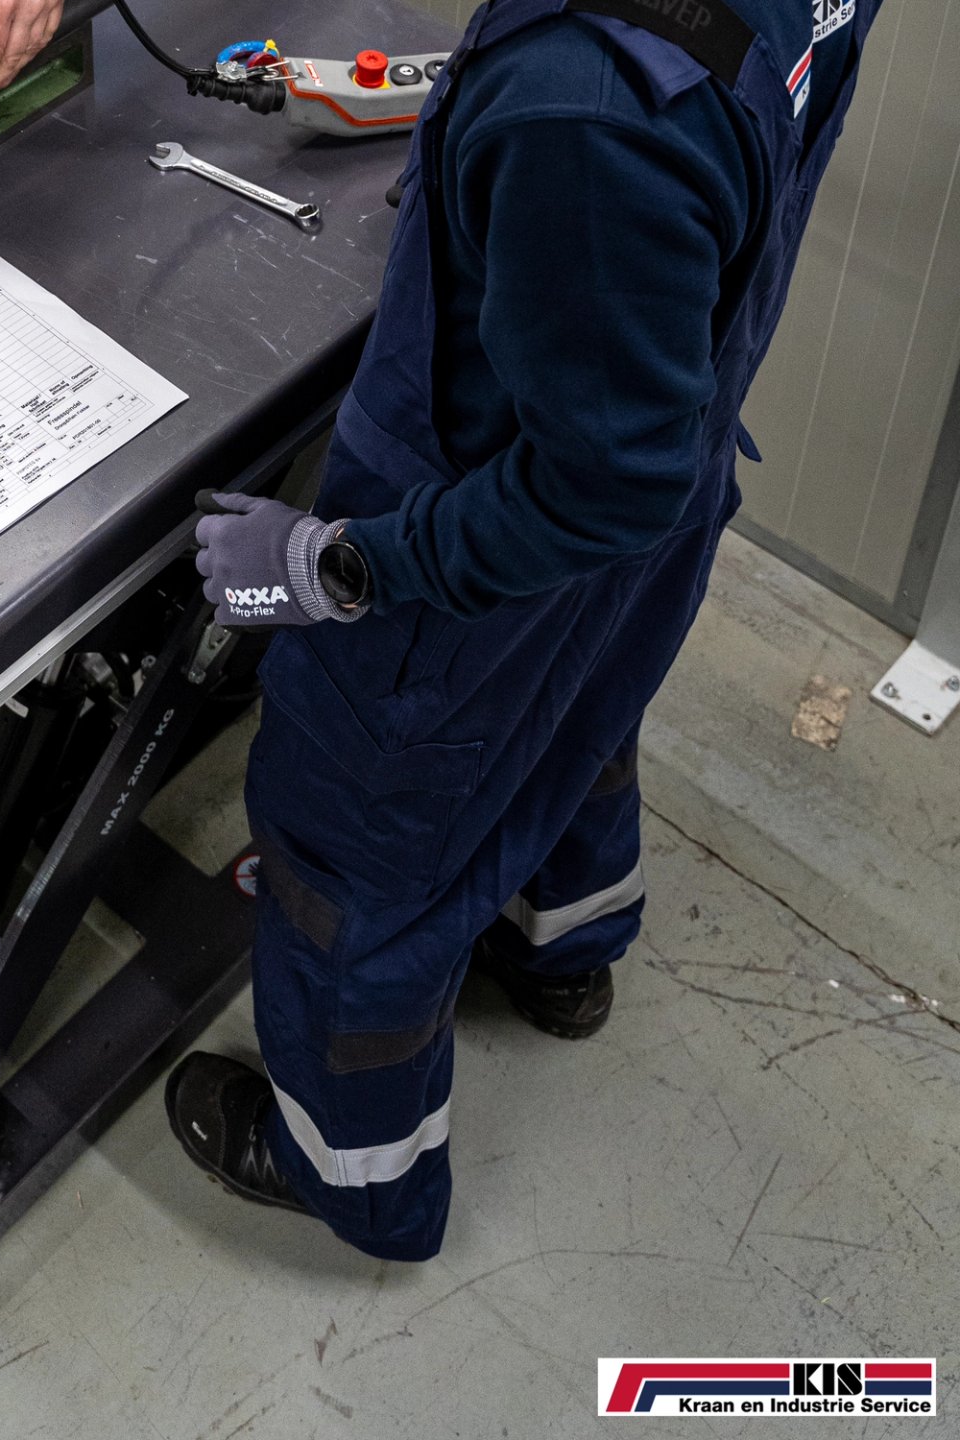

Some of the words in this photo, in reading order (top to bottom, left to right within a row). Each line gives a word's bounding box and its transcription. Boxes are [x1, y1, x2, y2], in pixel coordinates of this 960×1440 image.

[47, 400, 82, 425] Freesspindel
[225, 586, 289, 606] OXXA
[230, 605, 276, 618] X-Pro-Flex
[100, 792, 130, 835] MAX
[127, 741, 157, 787] 2000
[154, 708, 175, 736] KG
